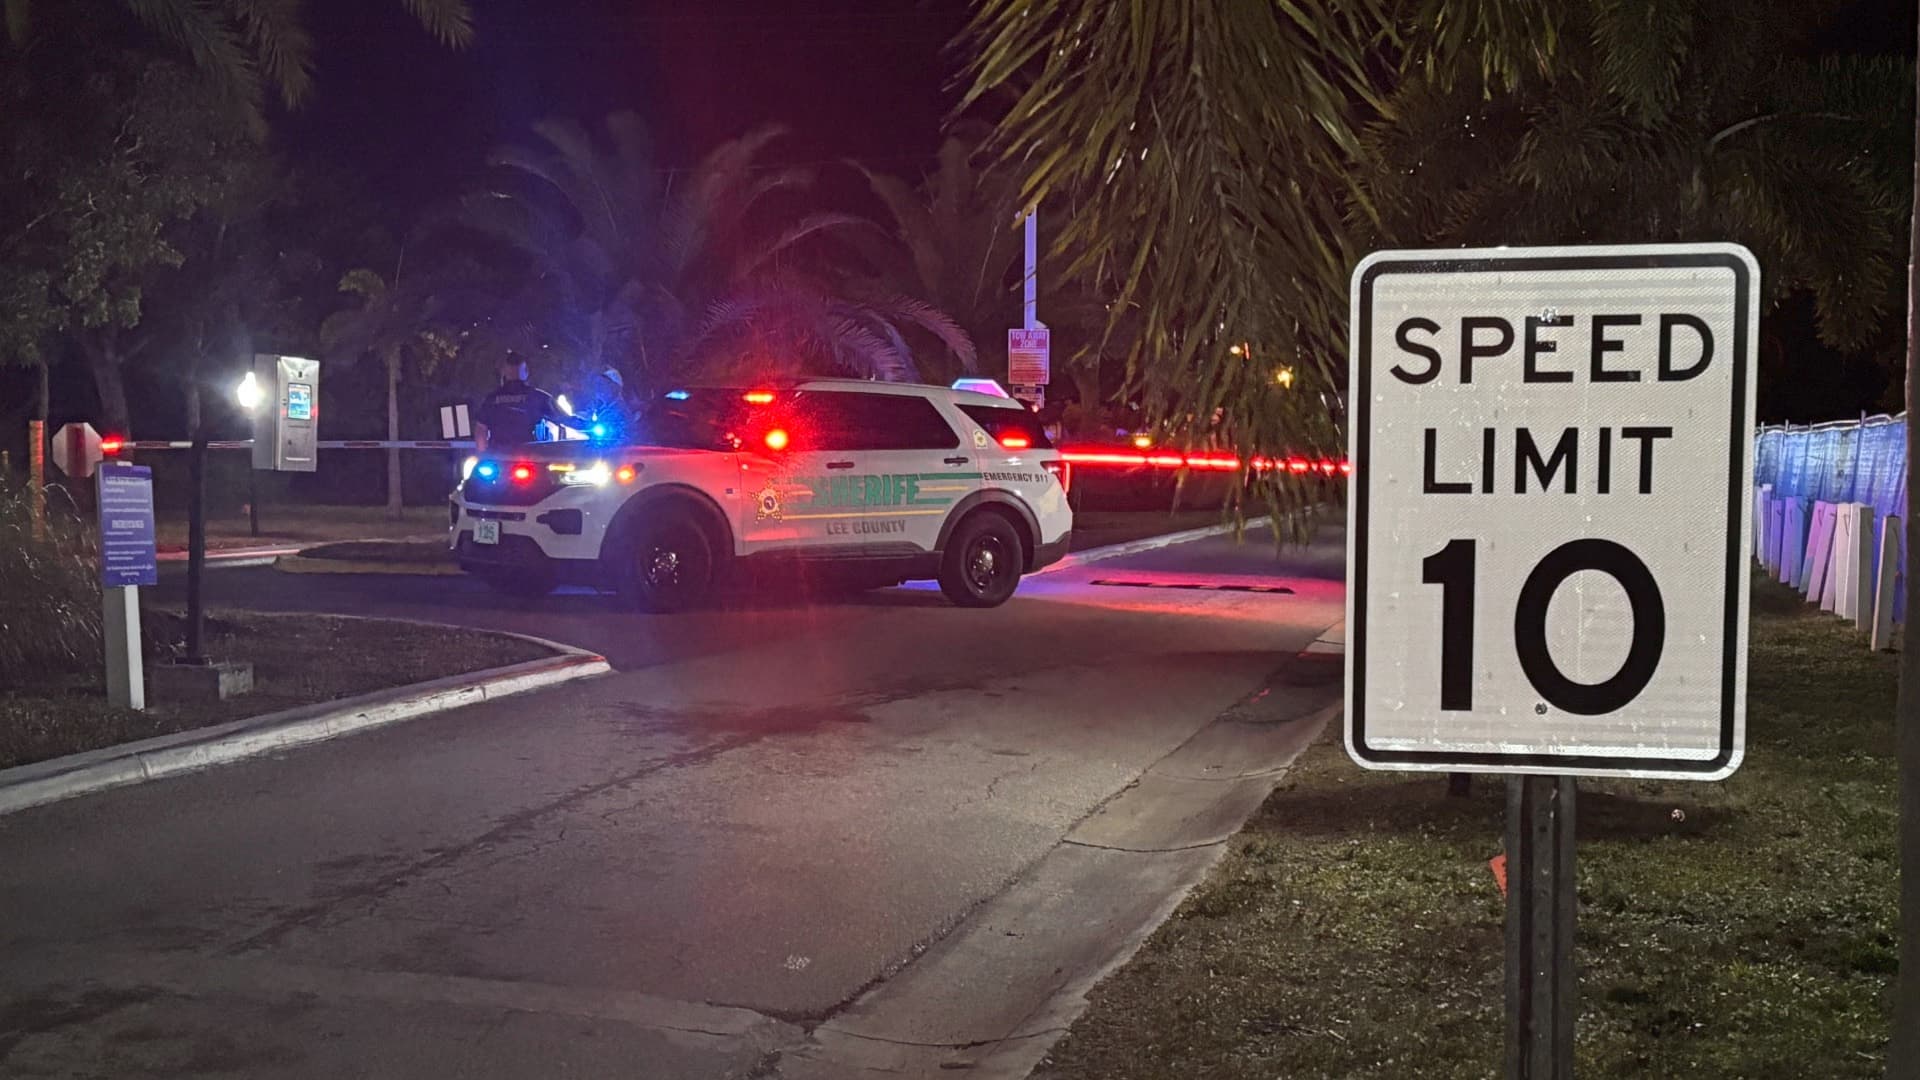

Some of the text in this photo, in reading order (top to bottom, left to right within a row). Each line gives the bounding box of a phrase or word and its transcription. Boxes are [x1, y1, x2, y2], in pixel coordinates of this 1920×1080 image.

[1390, 314, 1714, 385] SPEED
[983, 472, 1049, 483] EMERGENCY 911
[1423, 427, 1673, 494] LIMIT
[813, 474, 920, 507] SHERIFF
[826, 519, 906, 535] LEE COUNTY
[1422, 538, 1666, 716] 10
